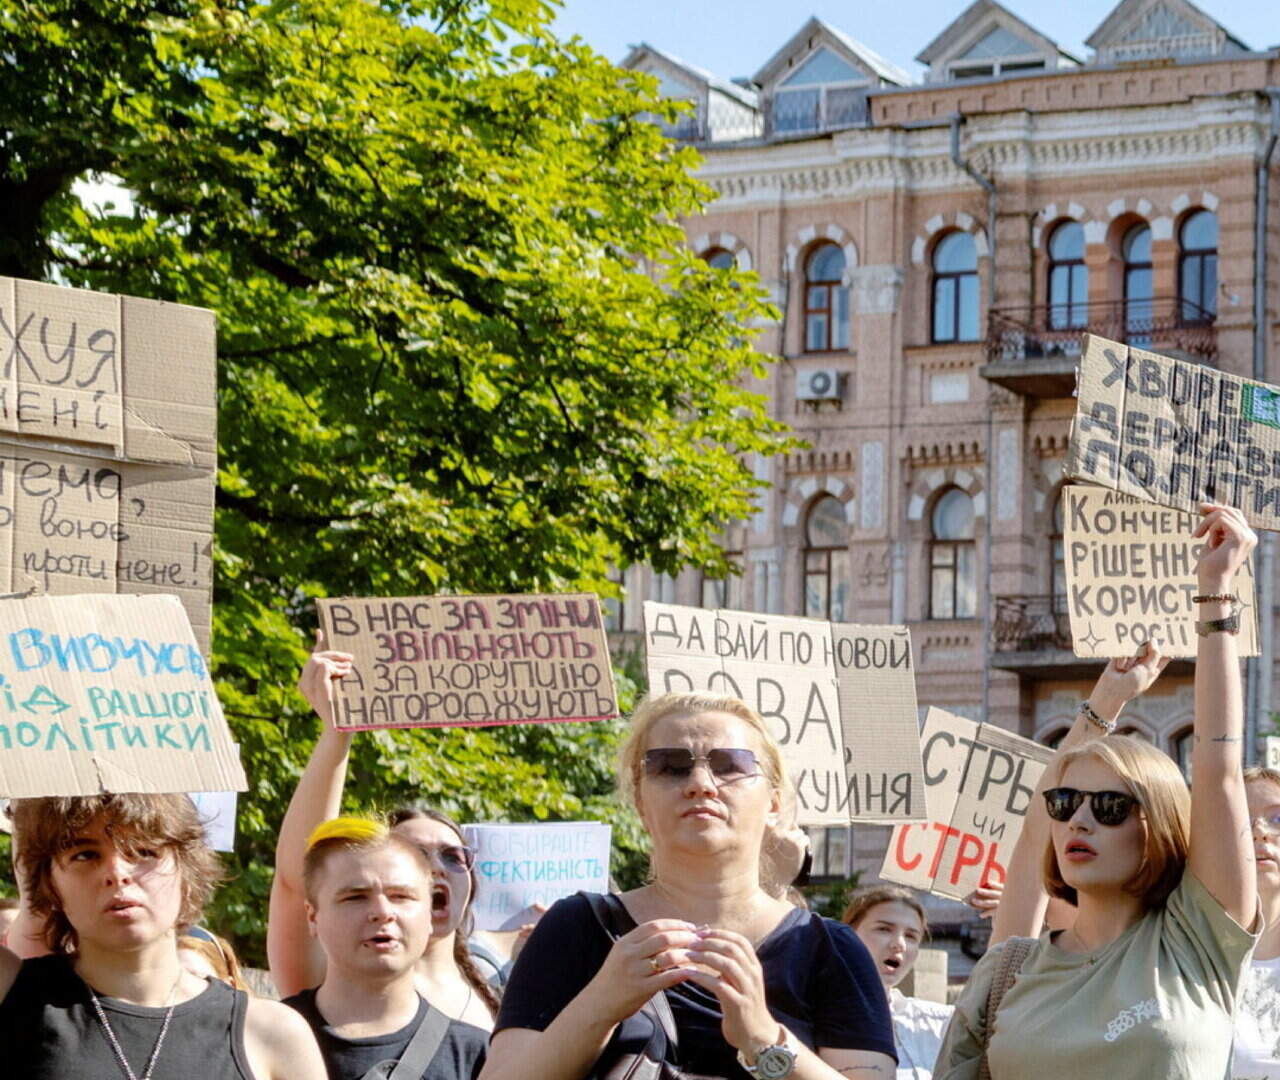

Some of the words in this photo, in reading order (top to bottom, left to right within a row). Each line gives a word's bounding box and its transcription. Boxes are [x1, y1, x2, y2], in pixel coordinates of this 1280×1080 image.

[1102, 348, 1240, 415] ХВОРЕ
[330, 604, 360, 636] В
[365, 602, 431, 630] НАС
[442, 600, 491, 631] ЗА
[779, 631, 813, 664] ПО
[373, 664, 418, 692] ЗА
